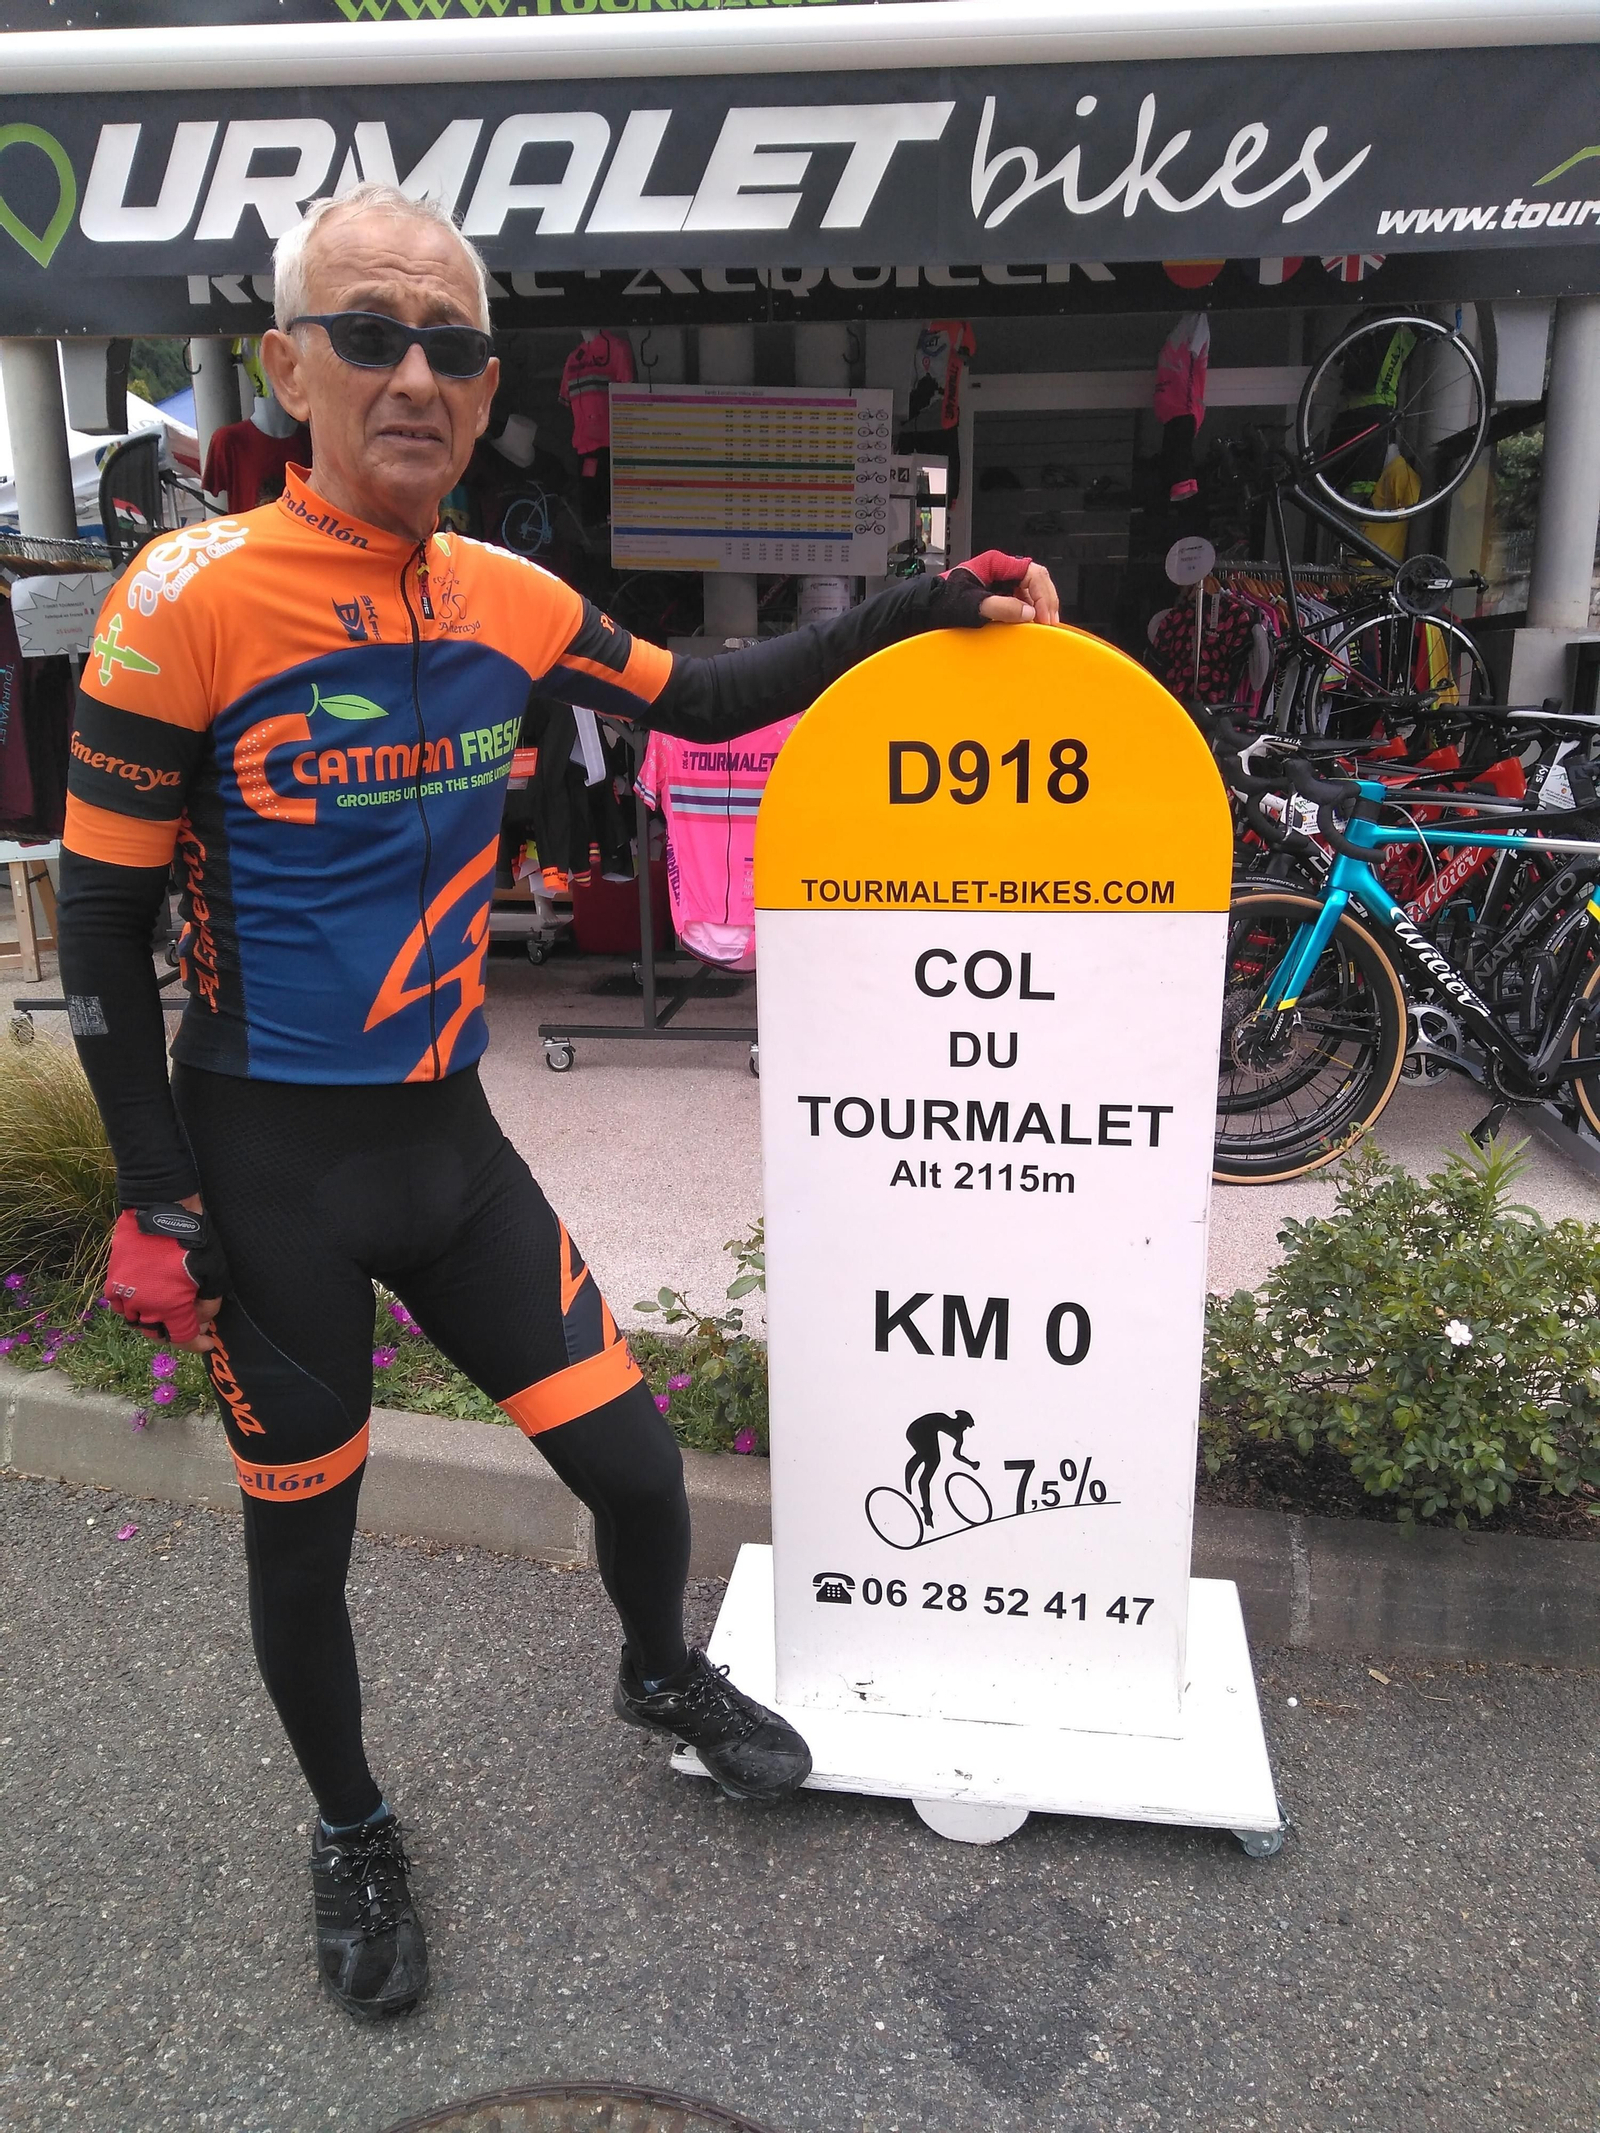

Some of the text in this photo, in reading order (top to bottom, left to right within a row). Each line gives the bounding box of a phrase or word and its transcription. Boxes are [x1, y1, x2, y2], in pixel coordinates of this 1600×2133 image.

[970, 92, 1371, 229] bikes
[1376, 198, 1600, 235] www.tour
[281, 489, 370, 550] Pabellón
[292, 716, 521, 785] CATMAN FRESH
[689, 751, 778, 772] TOURMALET
[889, 739, 1089, 804] D918
[336, 788, 402, 808] GROWERS
[403, 782, 444, 800] UNDER
[445, 776, 469, 793] THE
[471, 771, 494, 789] SAME
[802, 880, 1174, 904] TOURMALET-BIKES.COM
[915, 949, 1054, 1000] COL
[1390, 906, 1490, 1018] Wilier
[950, 1032, 1017, 1068] DU
[798, 1096, 1173, 1146] TOURMALET
[890, 1161, 1074, 1193] Alt 2115m
[876, 1290, 1091, 1365] KM 0
[863, 1578, 1154, 1625] 06 28 52 41 47
